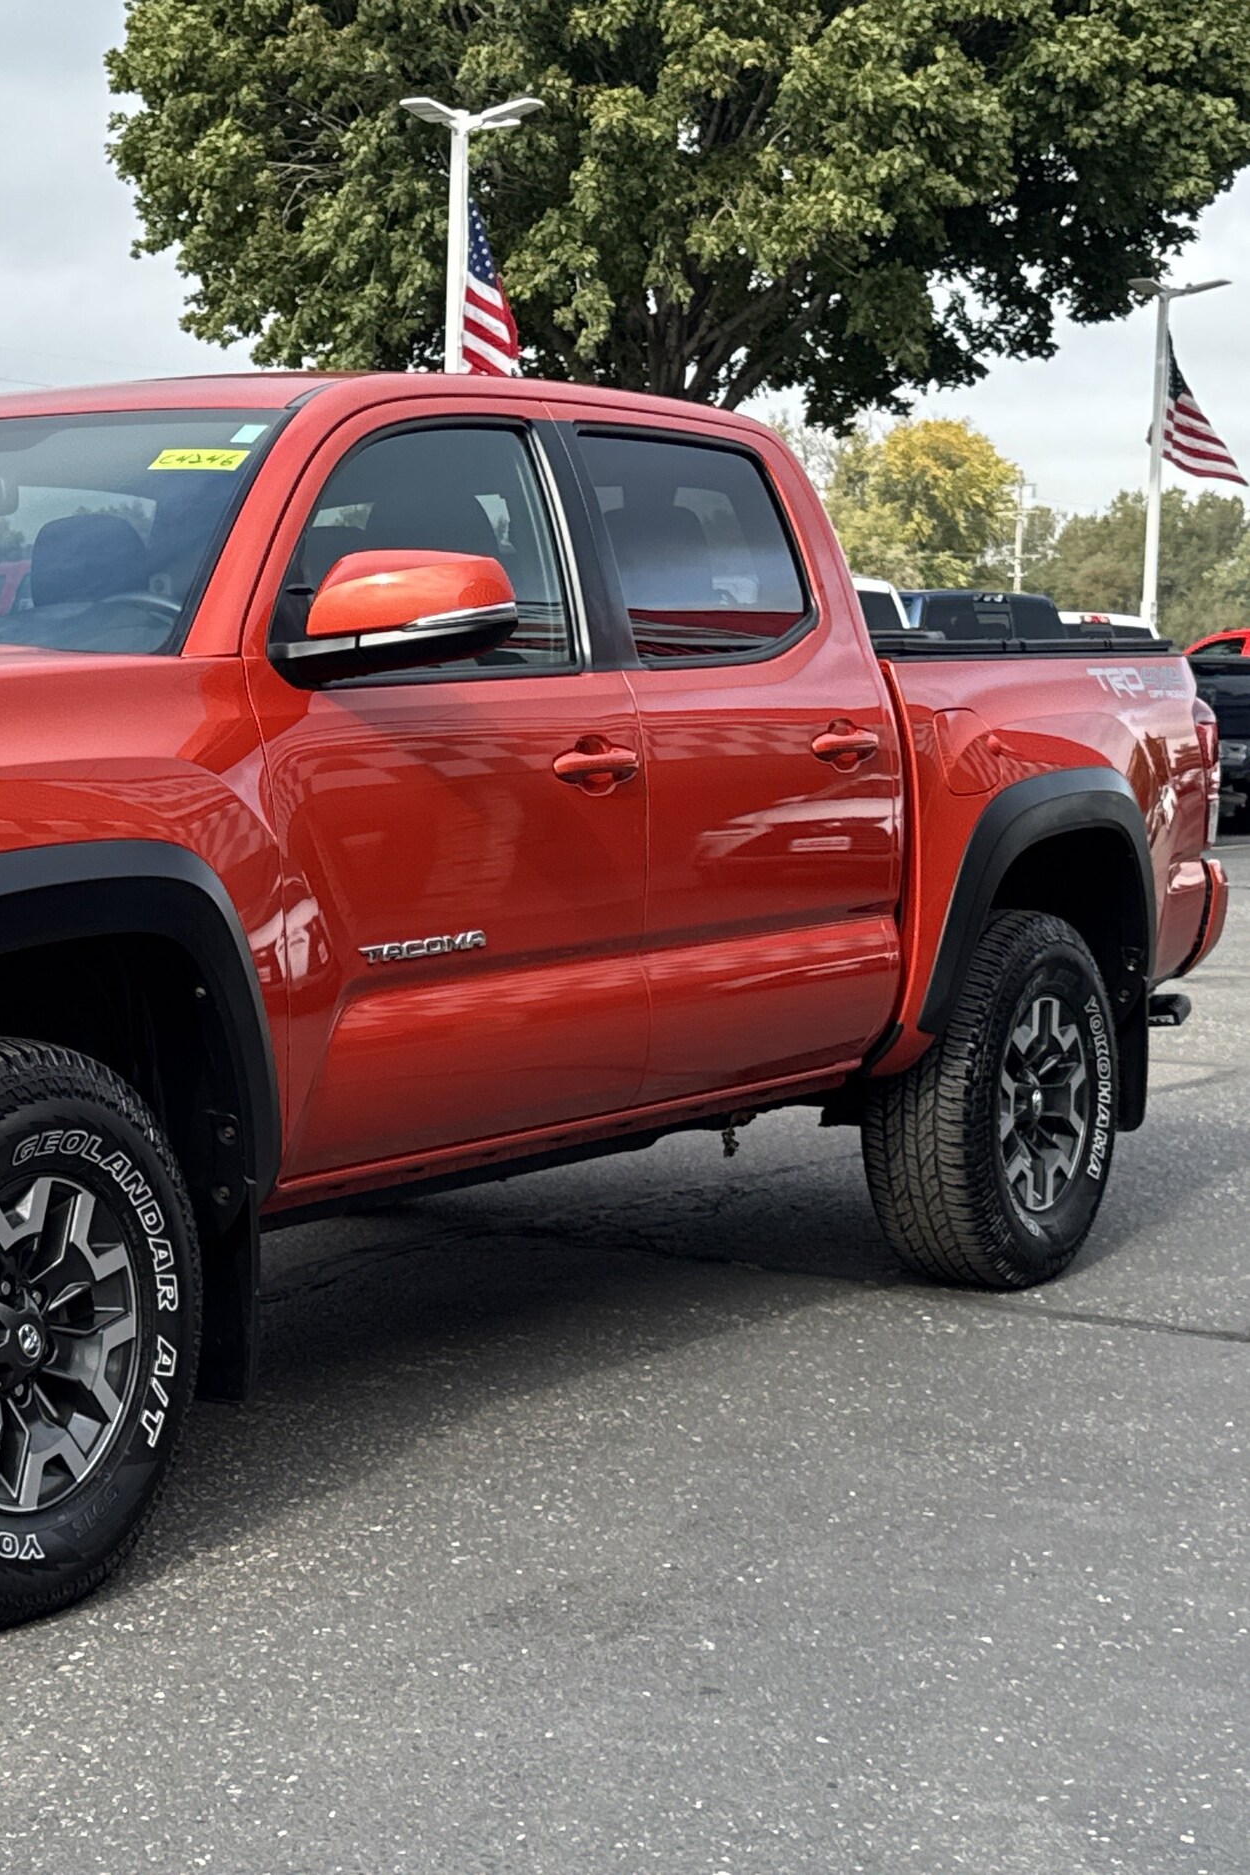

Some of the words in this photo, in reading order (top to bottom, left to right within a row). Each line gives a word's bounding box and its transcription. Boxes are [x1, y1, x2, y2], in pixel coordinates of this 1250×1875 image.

[158, 453, 239, 467] C4246
[1086, 666, 1146, 699] TRD
[358, 929, 488, 964] TACOMA
[1083, 994, 1112, 1181] YOKOHAMA
[12, 1129, 180, 1312] GEOLANDAR
[139, 1334, 178, 1448] A/T
